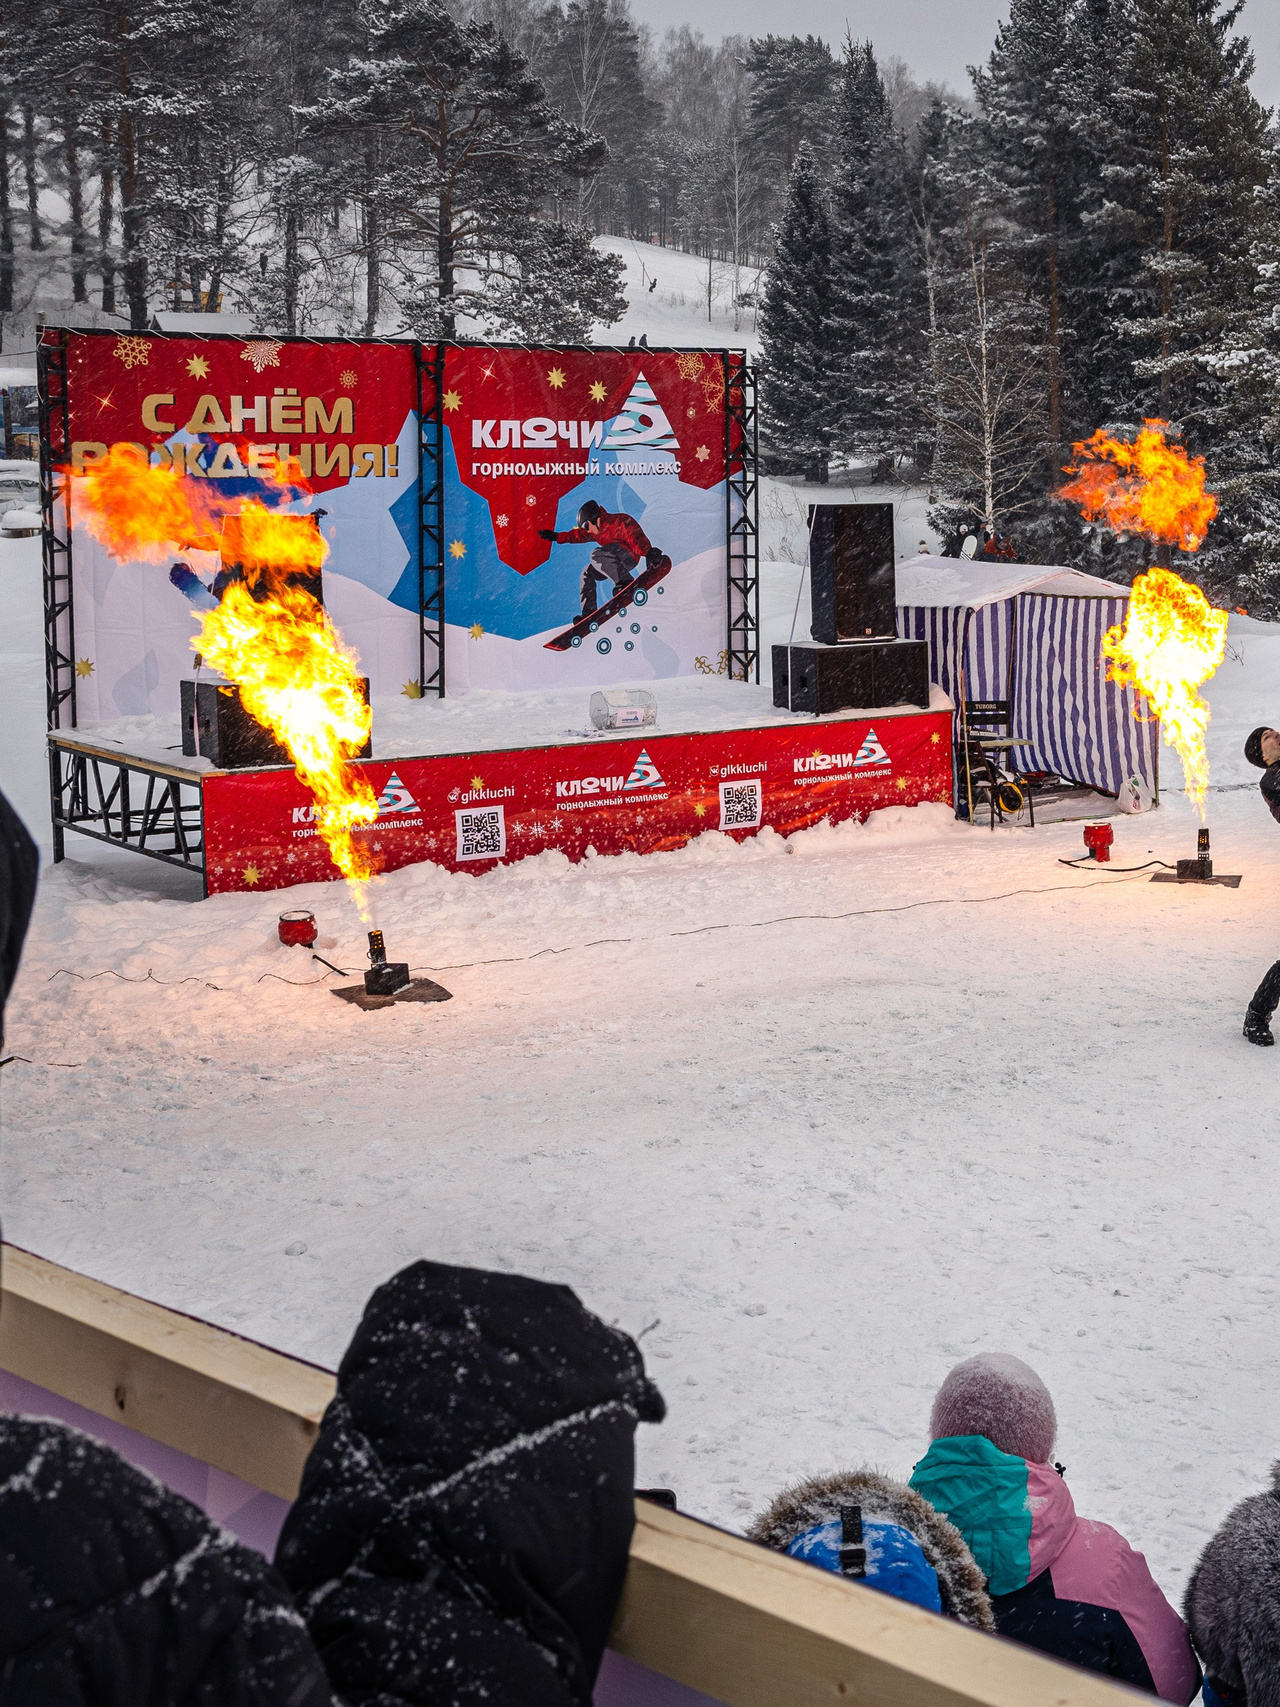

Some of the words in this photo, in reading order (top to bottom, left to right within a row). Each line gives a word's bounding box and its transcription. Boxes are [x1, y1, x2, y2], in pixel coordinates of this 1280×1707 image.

[141, 393, 176, 434] С
[186, 387, 355, 434] ДНЁМ
[472, 458, 600, 479] горнолыжный
[604, 461, 682, 476] комплекс
[720, 761, 768, 778] glkkluchi
[794, 771, 852, 785] горнолыжный
[854, 768, 892, 779] комплекс
[461, 787, 515, 804] glkkluchi
[556, 796, 623, 812] горнолыжный
[625, 792, 669, 803] комплекс
[373, 818, 424, 830] комплекс
